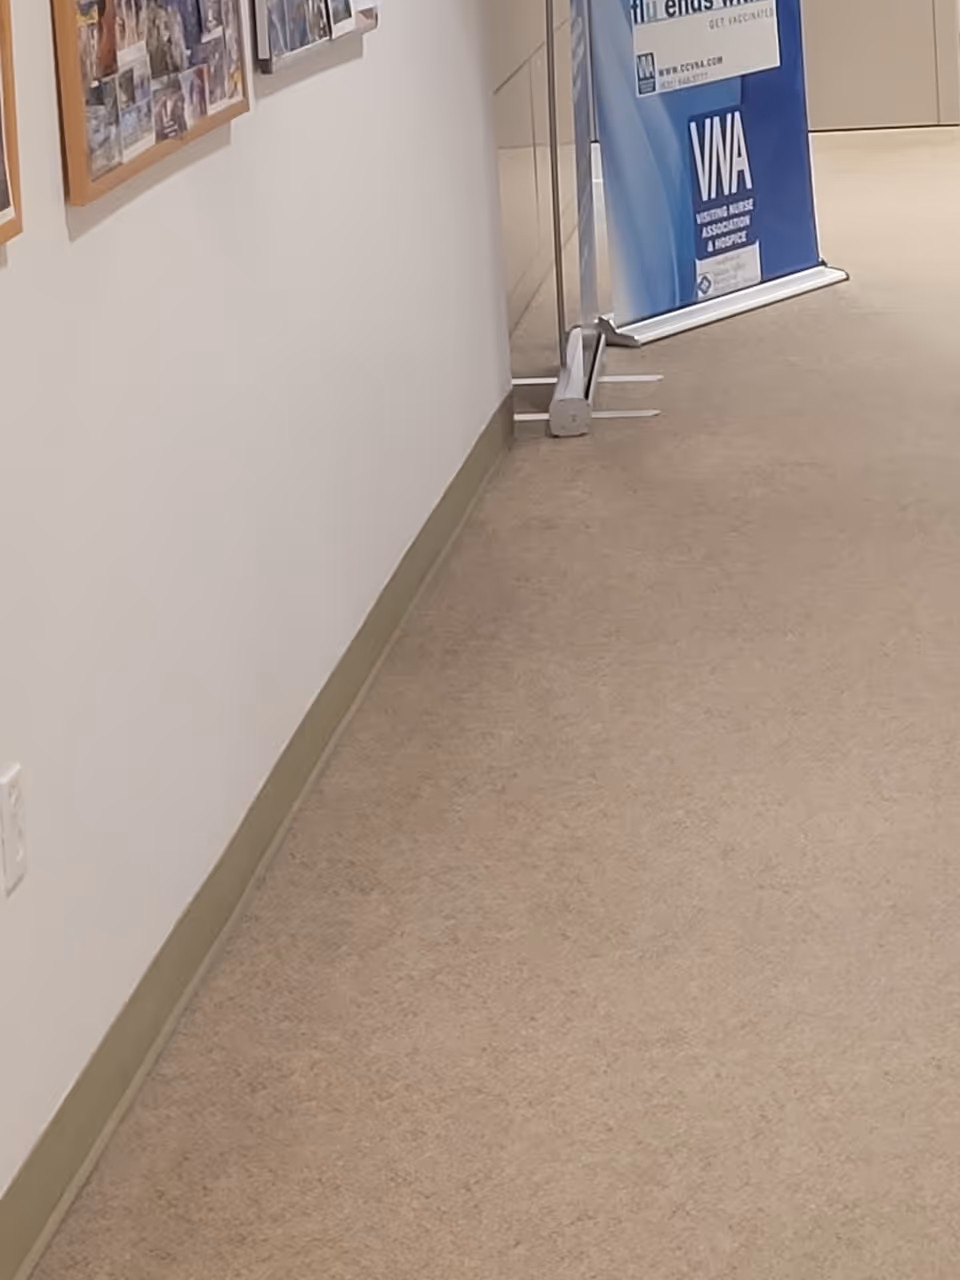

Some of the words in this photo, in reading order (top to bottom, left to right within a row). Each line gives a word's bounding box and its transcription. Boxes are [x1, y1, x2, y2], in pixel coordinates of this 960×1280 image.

[690, 111, 752, 201] VNA
[696, 206, 728, 225] VISITING
[729, 198, 754, 216] NURSE
[702, 215, 750, 239] ASSOCIATION
[715, 230, 747, 250] HOSPICE
